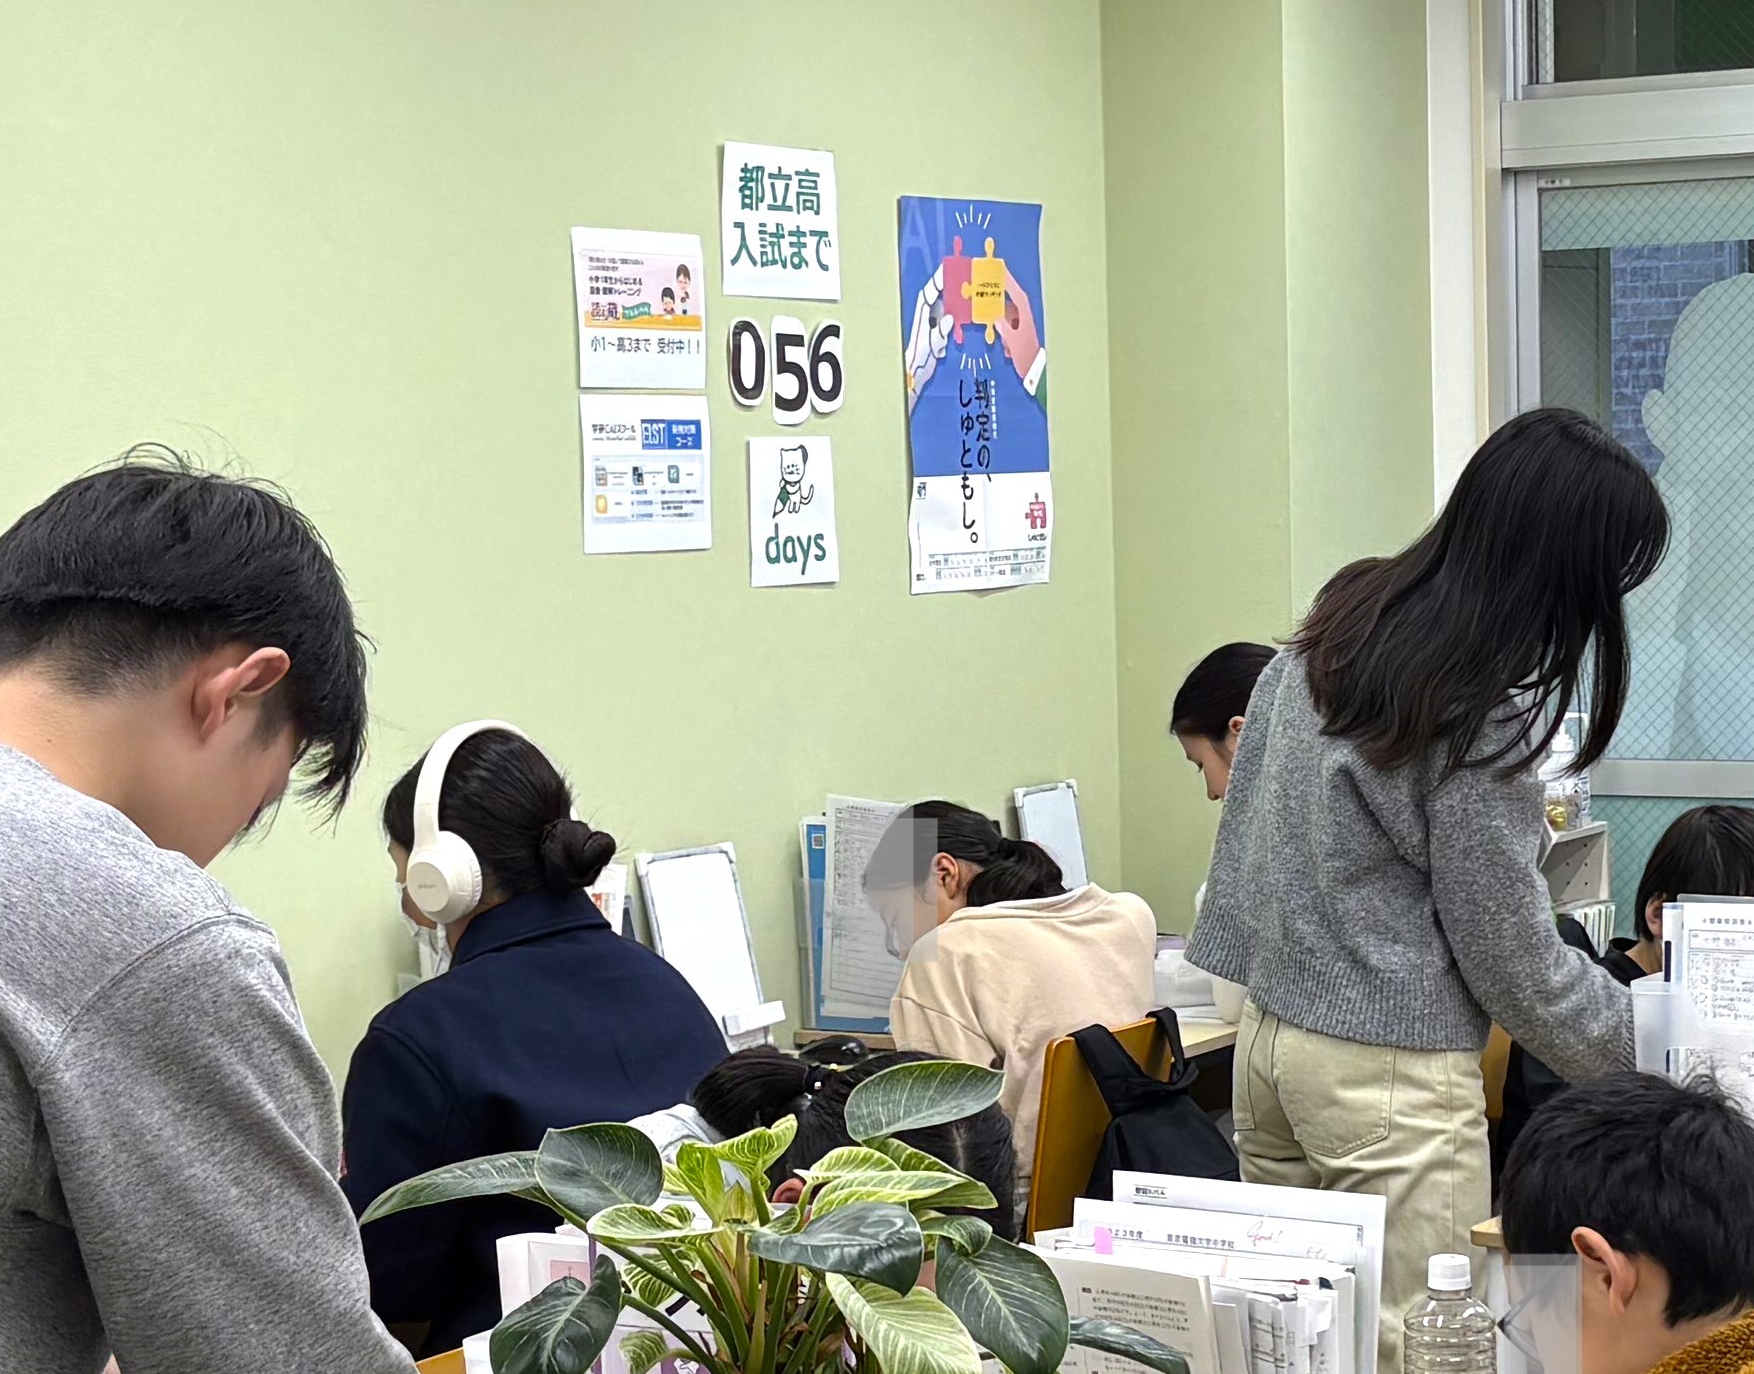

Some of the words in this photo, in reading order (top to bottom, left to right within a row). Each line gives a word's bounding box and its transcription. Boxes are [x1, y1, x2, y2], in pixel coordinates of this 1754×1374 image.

[738, 162, 821, 216] 都立高
[730, 221, 832, 272] 入試まで
[732, 320, 844, 412] 056
[959, 379, 979, 543] しゅともし。
[974, 378, 991, 483] 判定の、
[765, 522, 827, 576] days
